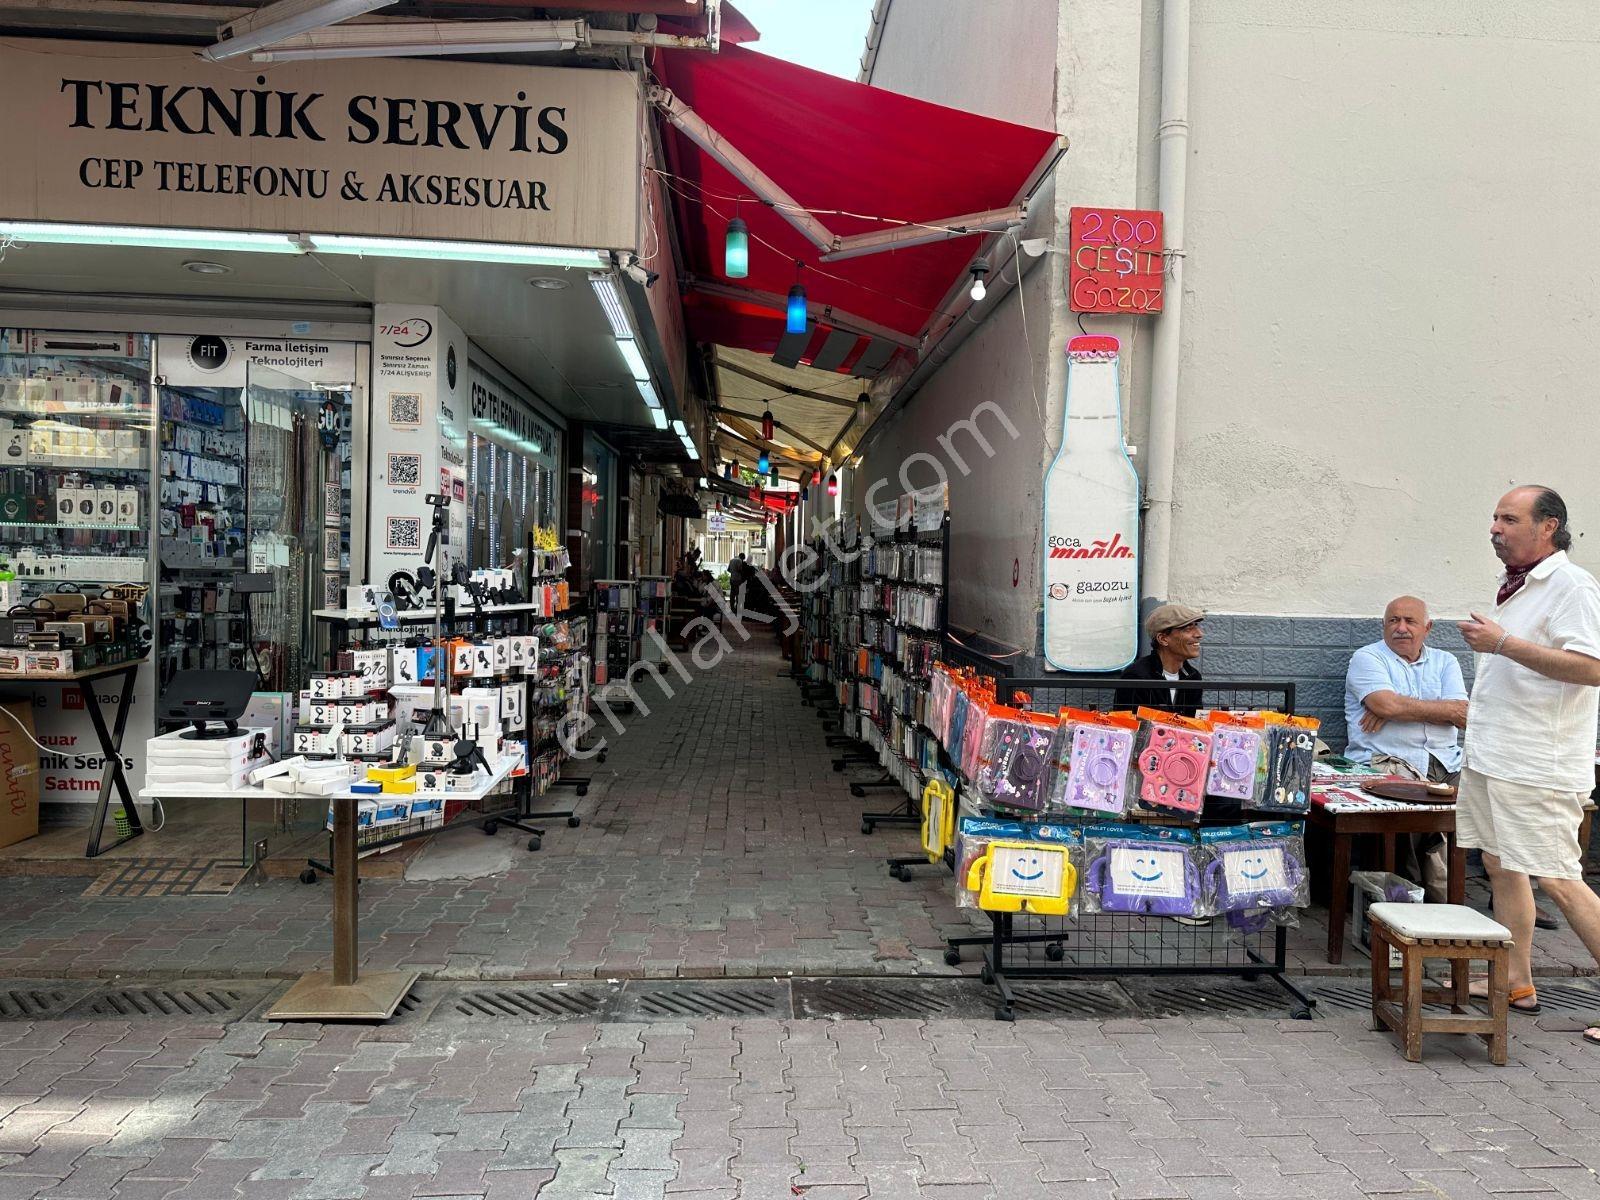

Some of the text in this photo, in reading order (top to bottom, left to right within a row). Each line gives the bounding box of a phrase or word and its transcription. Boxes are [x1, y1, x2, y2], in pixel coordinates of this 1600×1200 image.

[61, 75, 569, 155] TEKNİK SERVİS
[80, 157, 551, 211] CEP TELEFONU & AKSESUAR
[1081, 213, 1157, 244] 200
[1073, 276, 1162, 310] Gazoz
[380, 325, 409, 335] 7/24
[245, 341, 282, 352] Farma
[284, 340, 329, 355] İletişim
[250, 356, 324, 368] Teknolojileri
[471, 381, 487, 419] CEP
[1048, 535, 1081, 548] goca
[1076, 581, 1129, 594] gazozu
[45, 776, 101, 791] Satım
